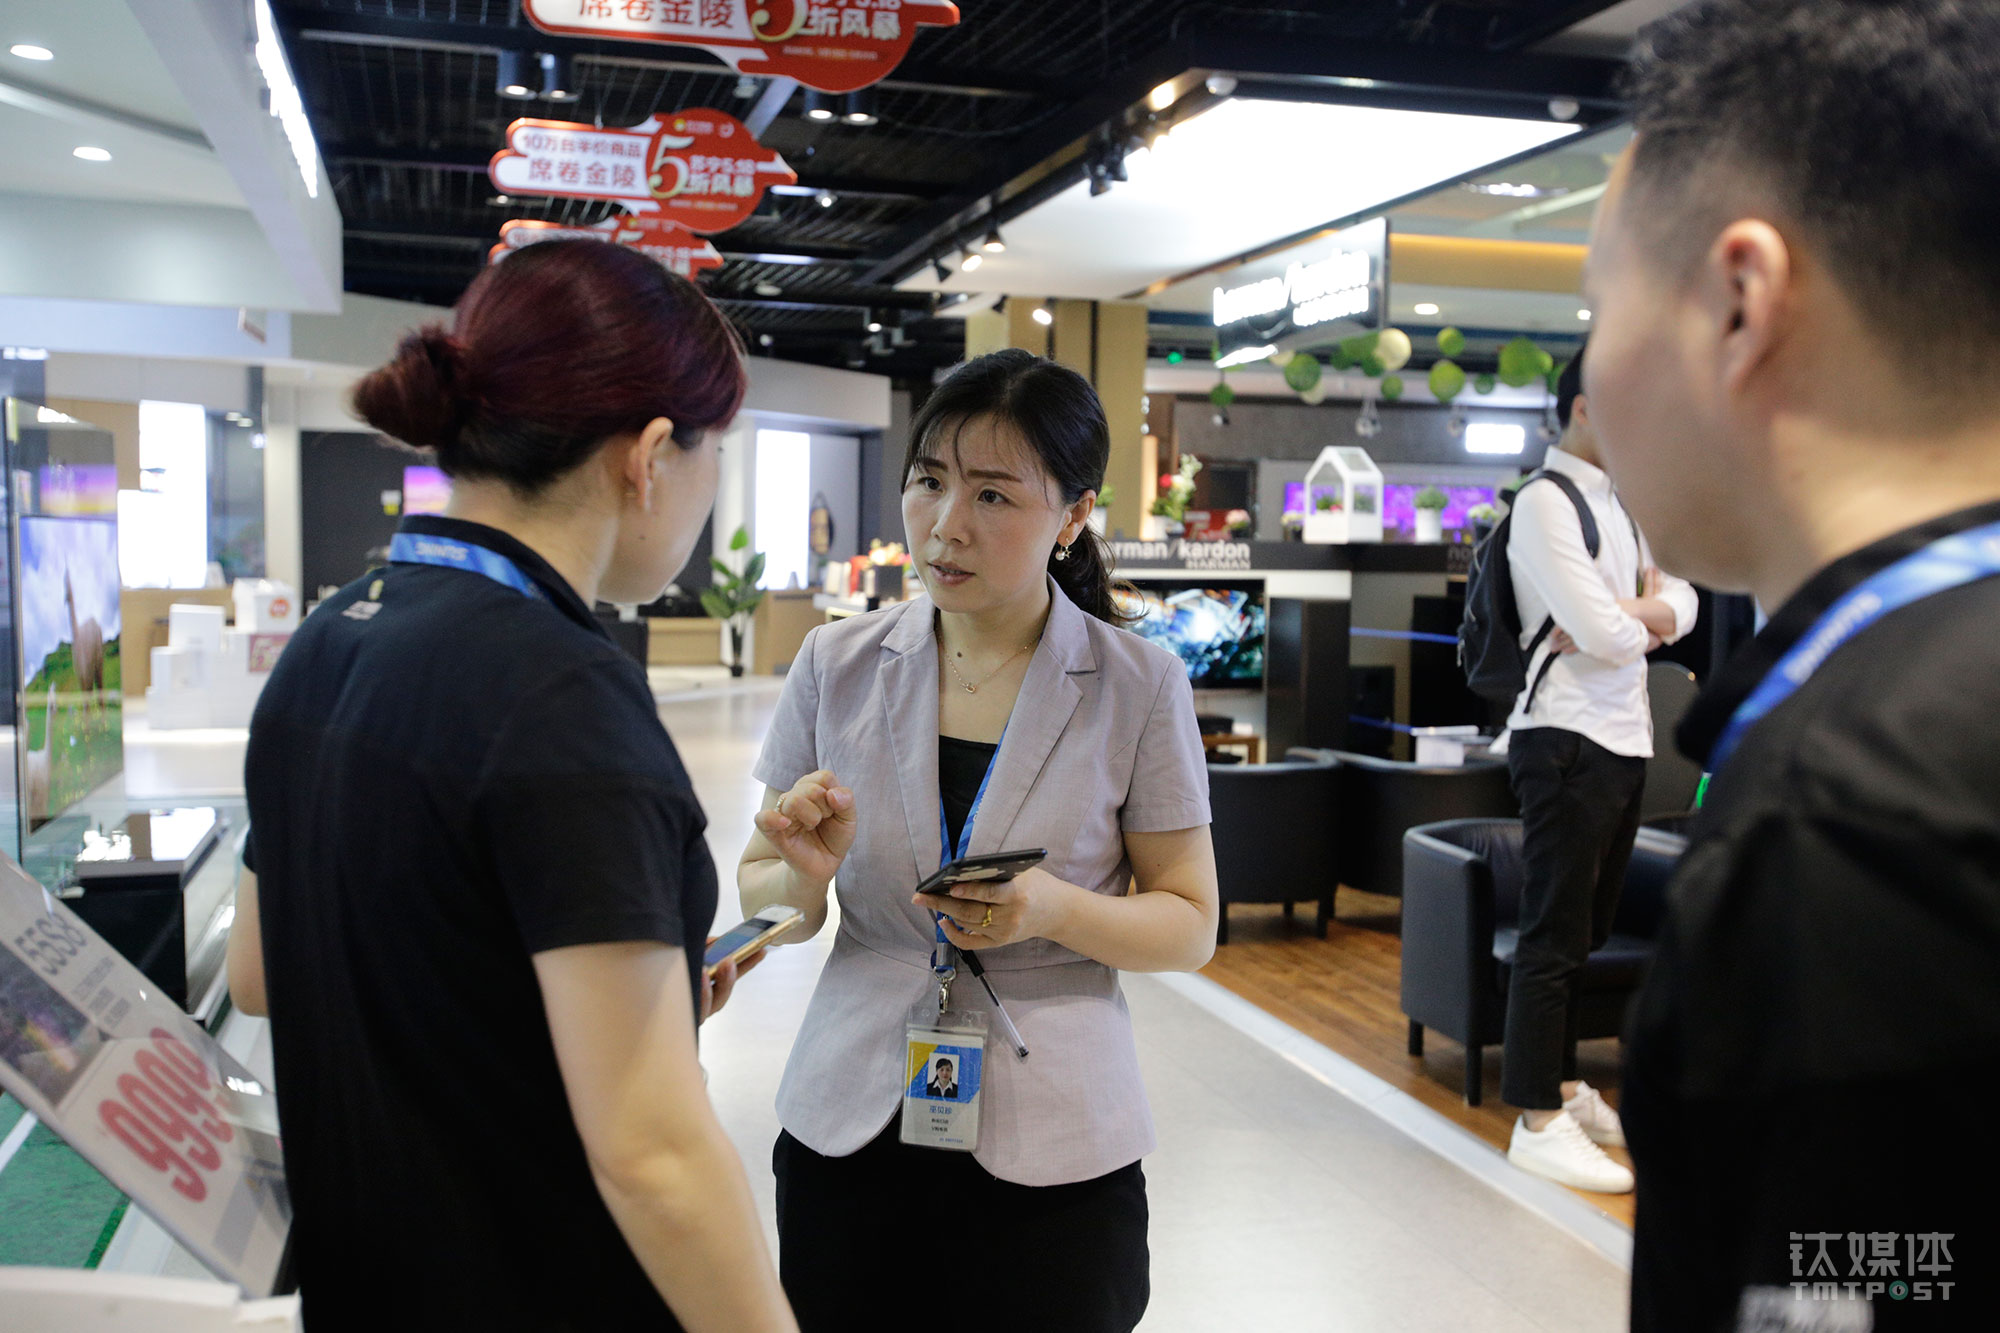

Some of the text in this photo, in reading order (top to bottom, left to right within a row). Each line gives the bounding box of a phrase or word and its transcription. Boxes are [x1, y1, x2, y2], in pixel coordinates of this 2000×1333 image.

[529, 158, 636, 187] 席卷金陵
[1109, 538, 1250, 560] rman/kardon
[98, 1027, 238, 1203] 9999
